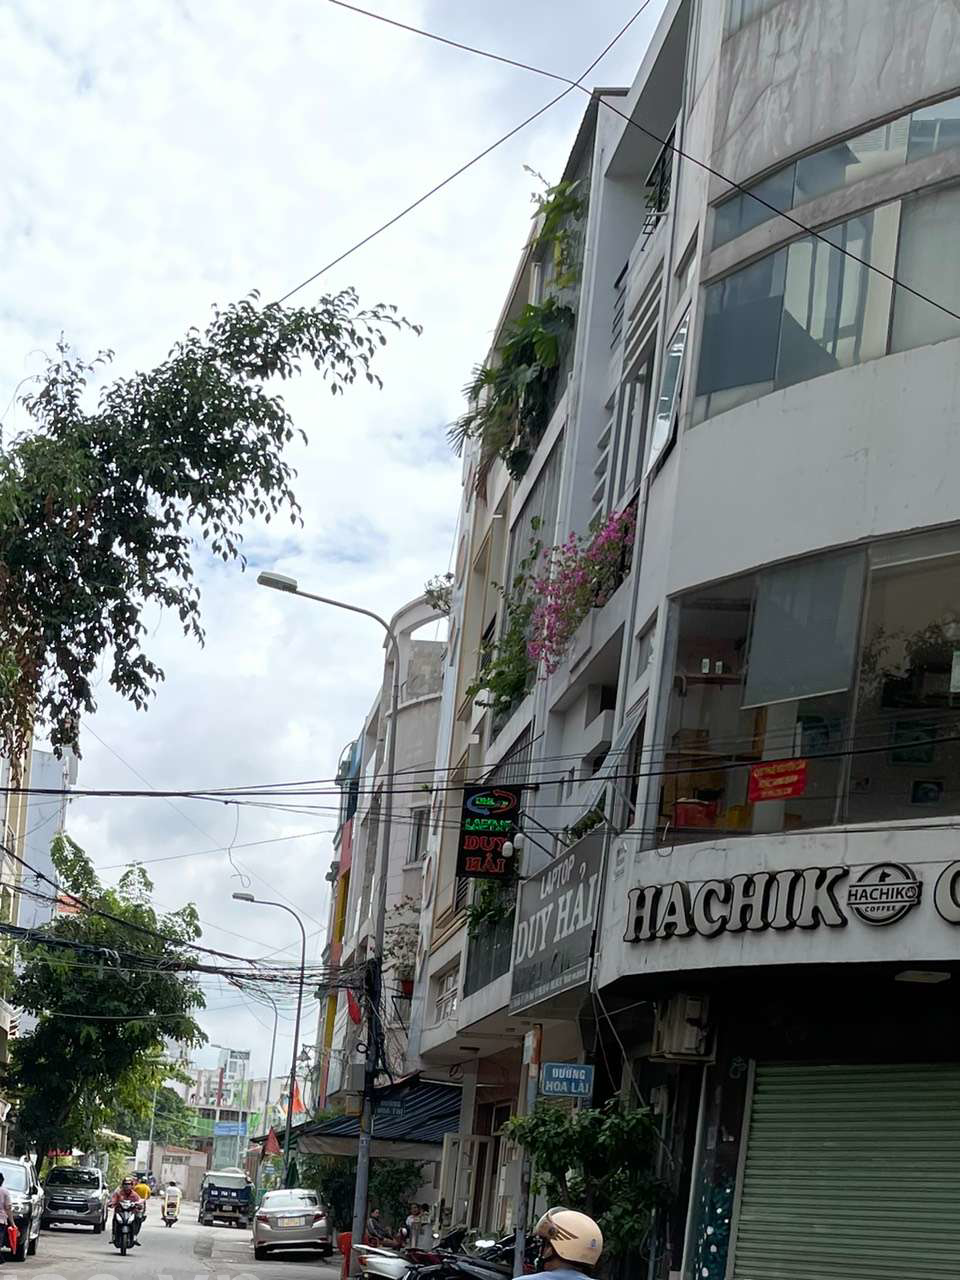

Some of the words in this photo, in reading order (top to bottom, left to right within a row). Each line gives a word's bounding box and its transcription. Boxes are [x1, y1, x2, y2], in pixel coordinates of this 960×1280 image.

[540, 853, 575, 900] LAPTOP
[515, 902, 554, 966] DUY
[553, 861, 599, 944] HẢI
[864, 904, 897, 913] COFFEE
[545, 1081, 568, 1092] HOA
